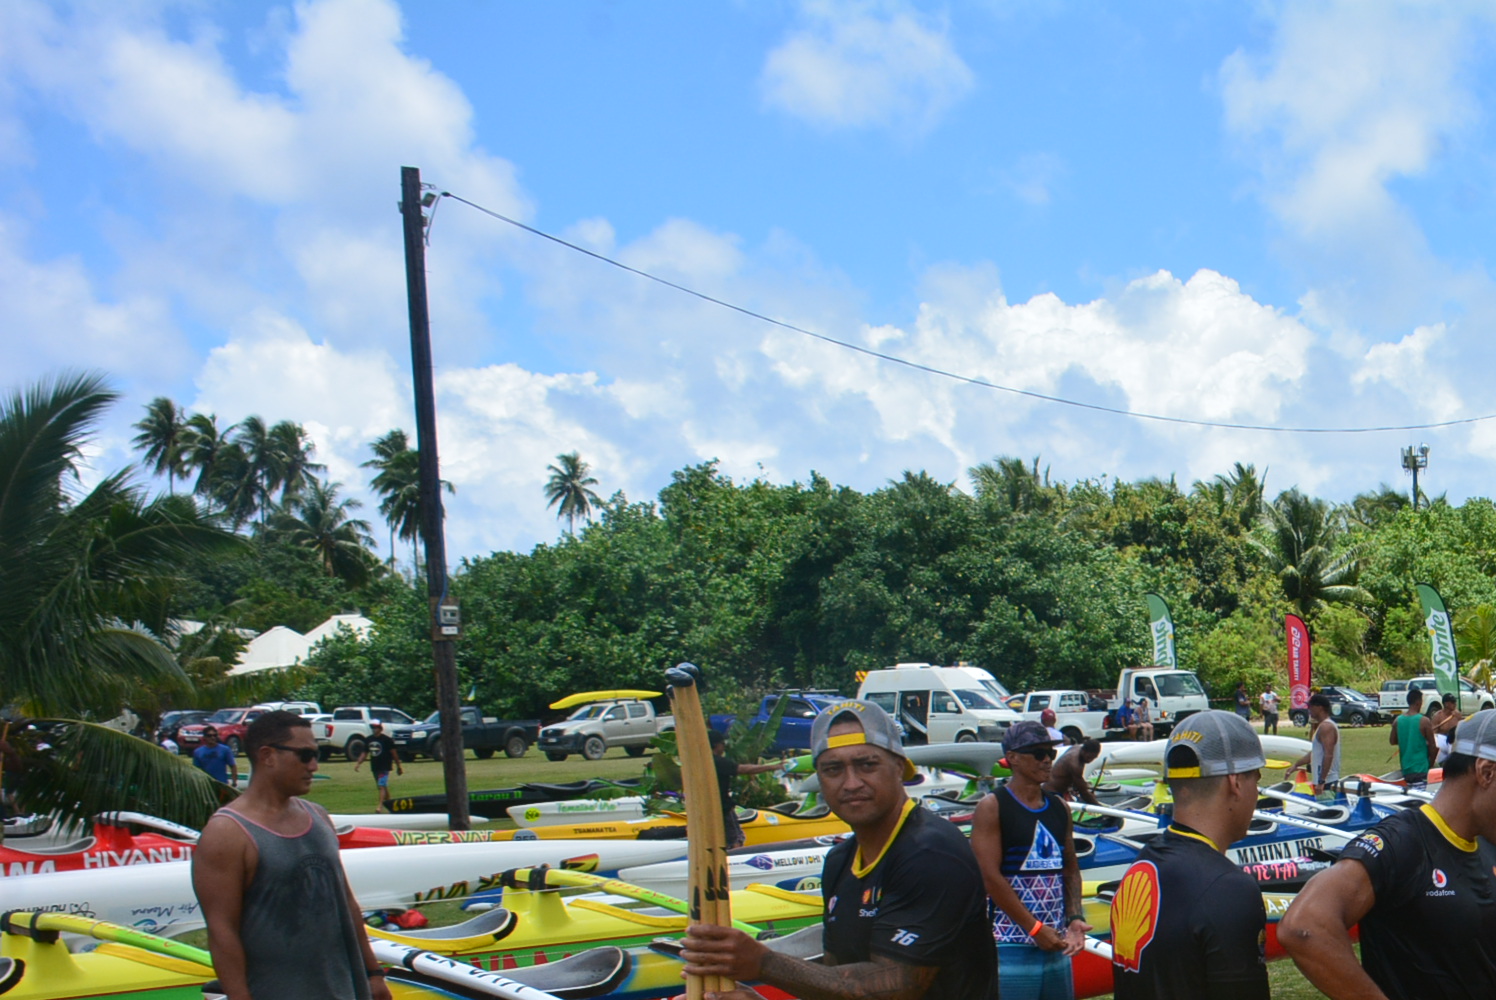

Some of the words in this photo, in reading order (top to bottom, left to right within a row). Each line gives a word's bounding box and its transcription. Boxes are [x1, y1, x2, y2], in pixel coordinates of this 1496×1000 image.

[1431, 614, 1454, 672] Sprite
[1292, 660, 1300, 681] TAHITI
[827, 702, 866, 716] TAHITI
[392, 831, 454, 846] VIPER
[83, 846, 192, 870] HIVANUI
[774, 856, 805, 867] MELLOW
[1235, 842, 1292, 865] MAHINA
[1426, 888, 1456, 898] vodafone
[890, 928, 919, 946] 76
